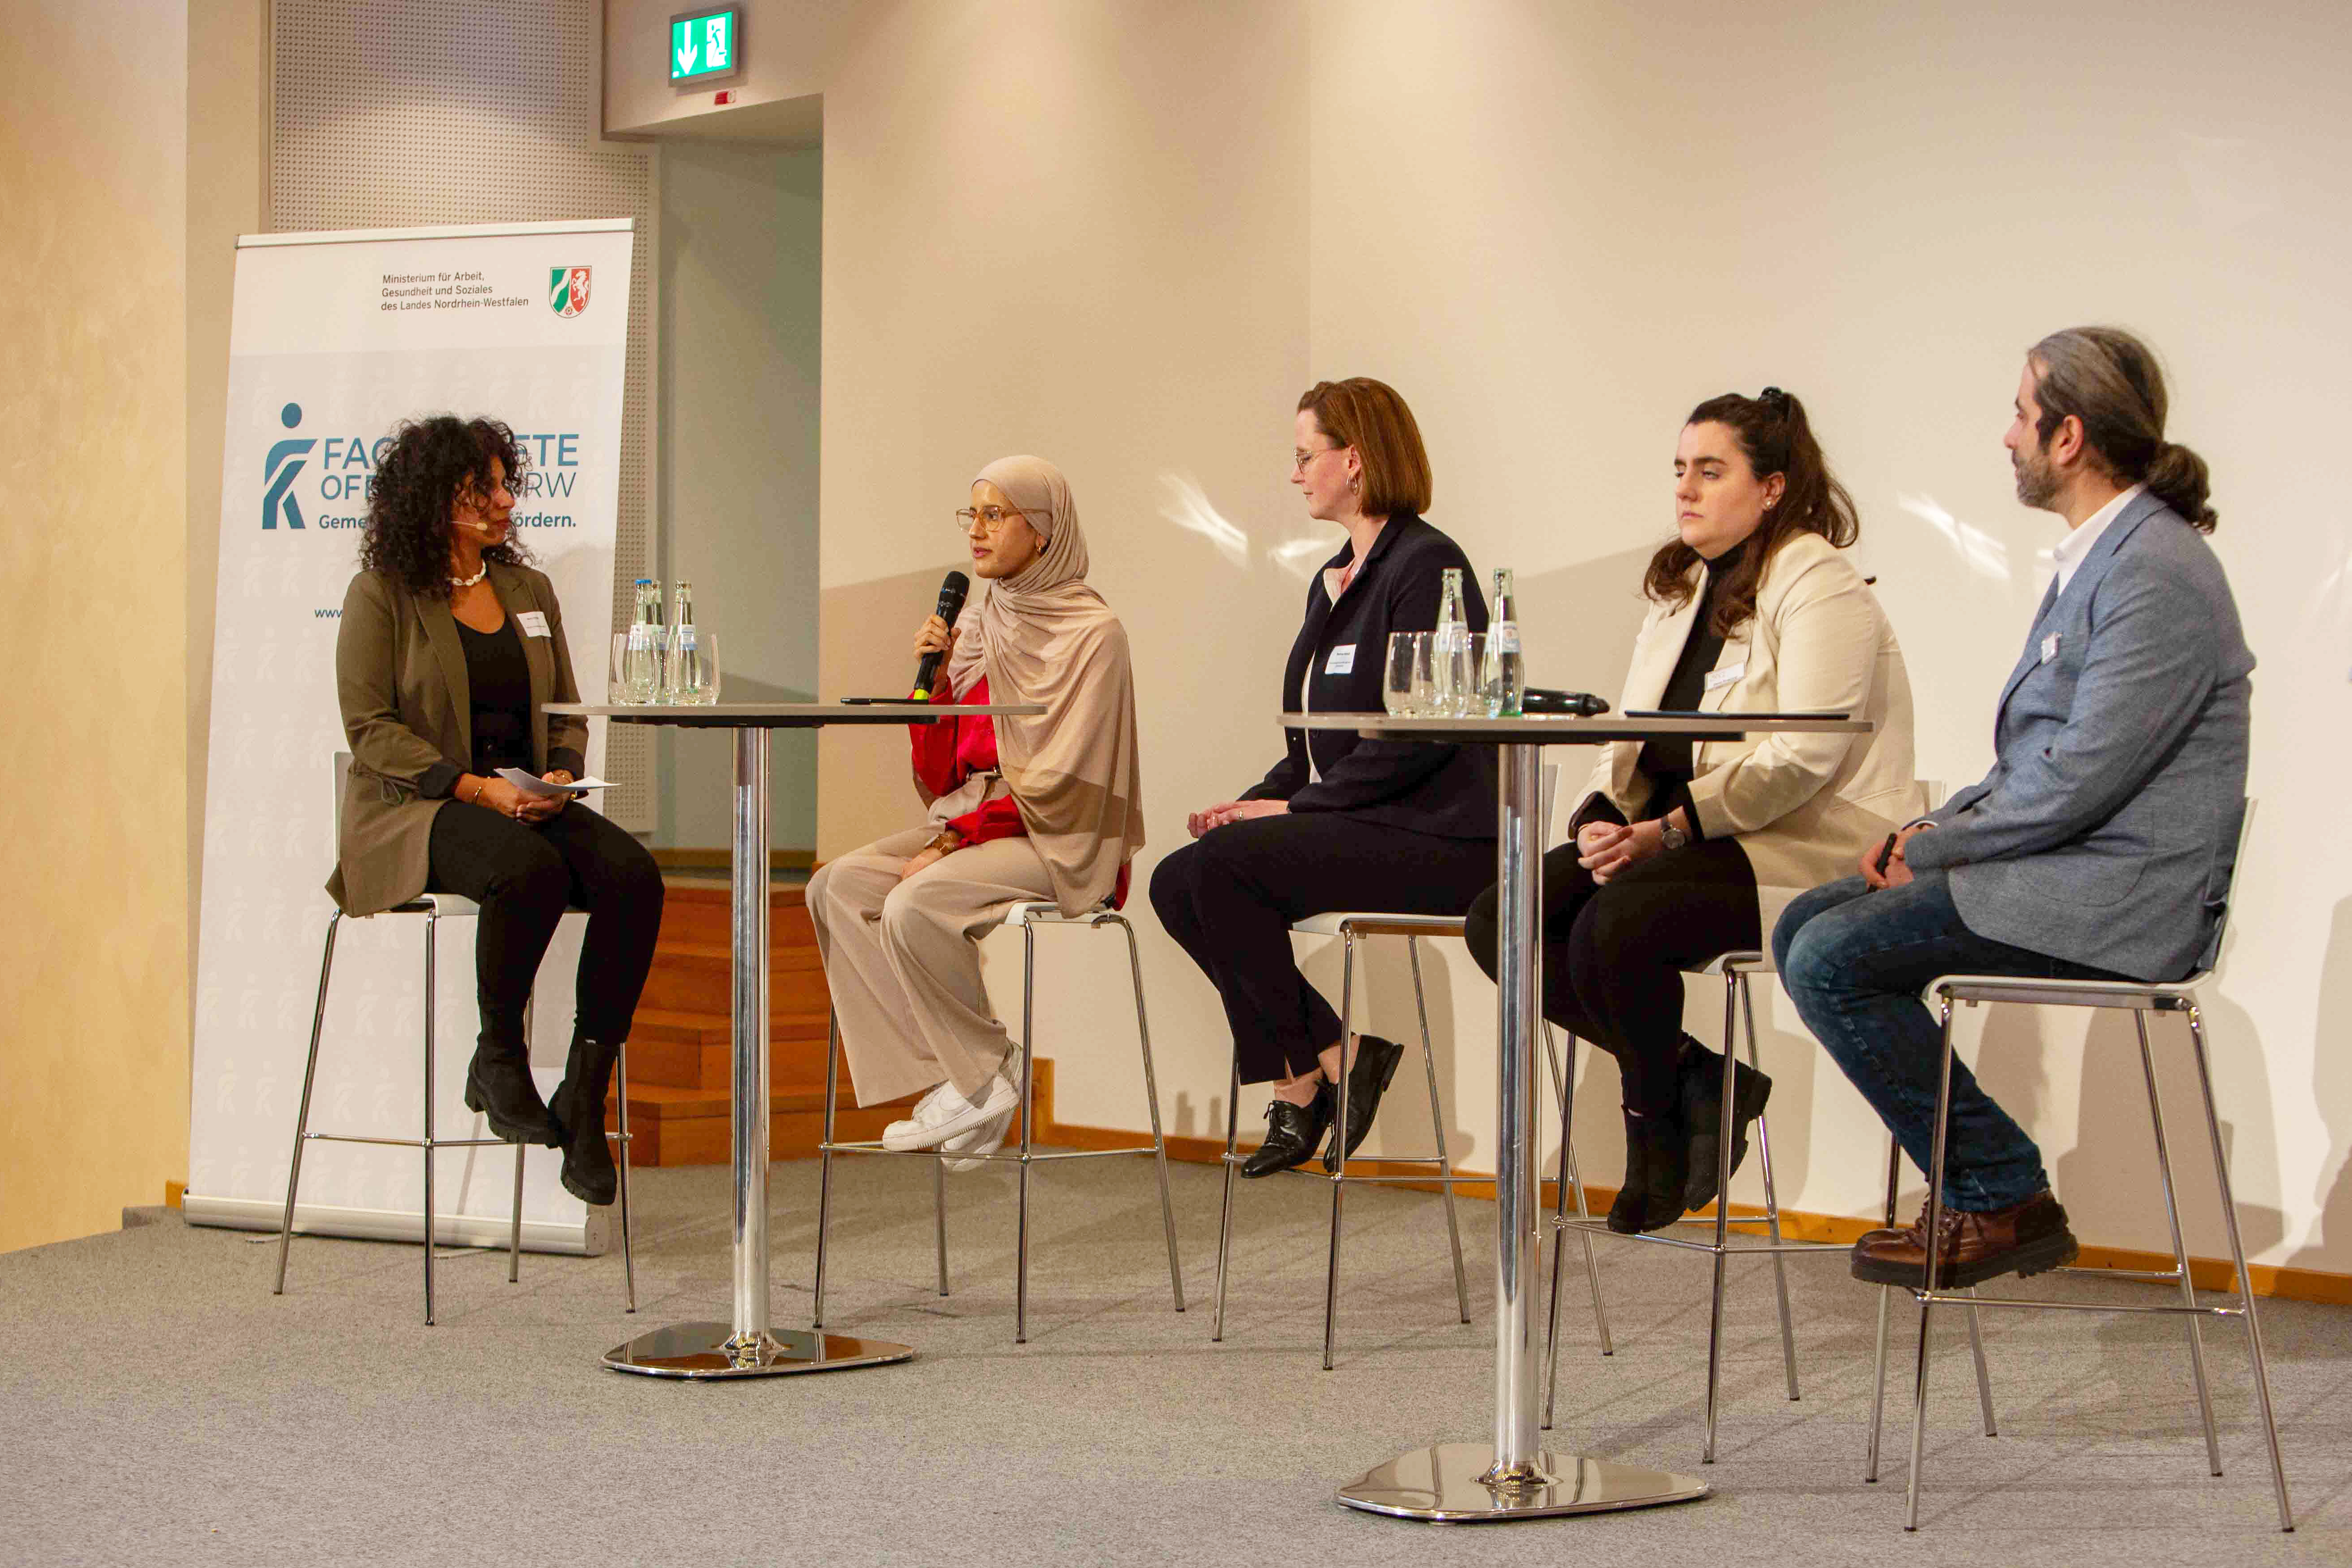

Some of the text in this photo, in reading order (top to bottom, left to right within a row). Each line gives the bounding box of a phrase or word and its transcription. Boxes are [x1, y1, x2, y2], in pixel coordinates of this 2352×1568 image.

[383, 272, 484, 284] Ministerium für Arbeit,
[382, 284, 493, 297] Gesundheit und Soziales
[381, 297, 529, 310] des Landes Nordrhein-Westfalen
[512, 511, 577, 527] ördern.
